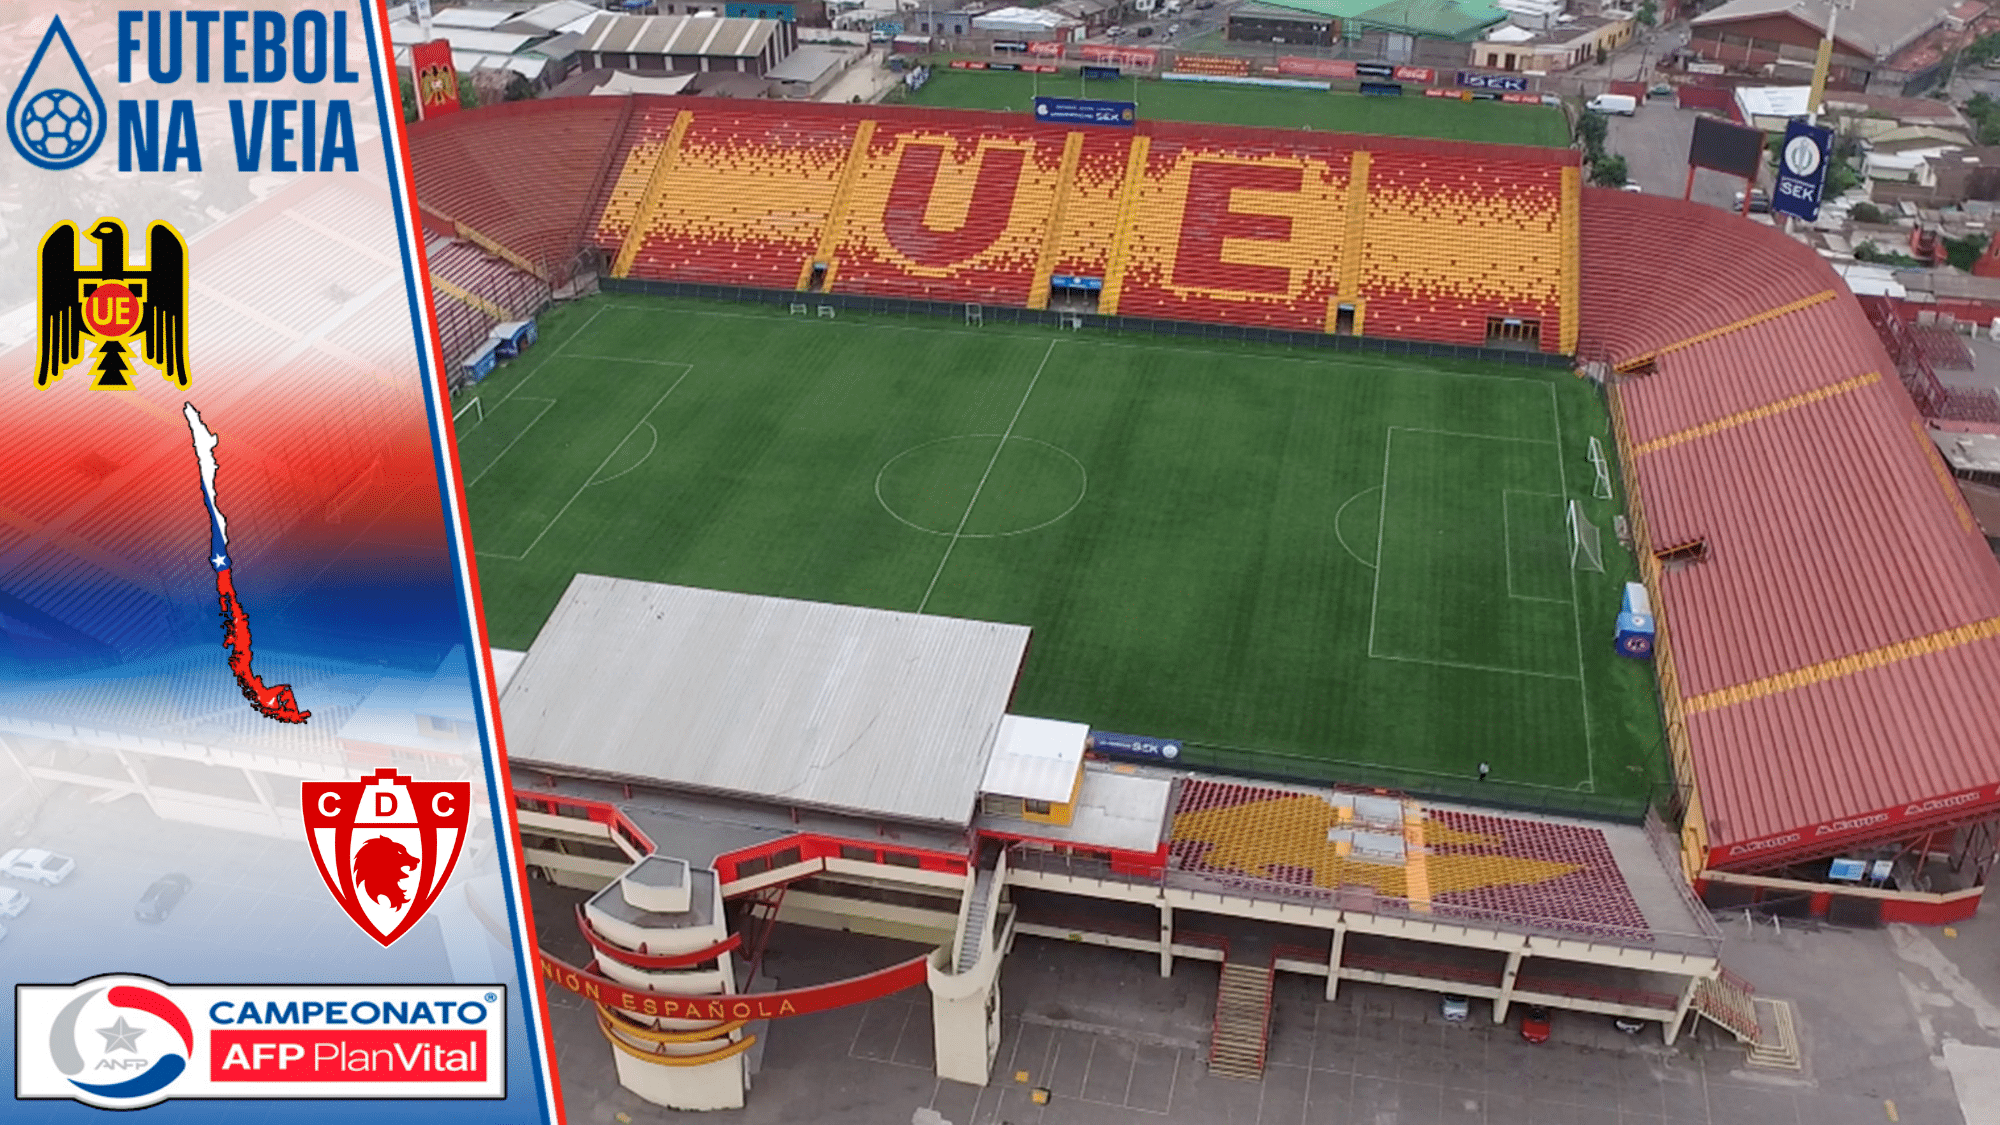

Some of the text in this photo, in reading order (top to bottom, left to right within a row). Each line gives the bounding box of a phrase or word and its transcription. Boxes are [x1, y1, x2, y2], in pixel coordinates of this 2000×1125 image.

[1779, 181, 1815, 203] SEK
[540, 957, 797, 1018] NIÓN ESPAÑOLA
